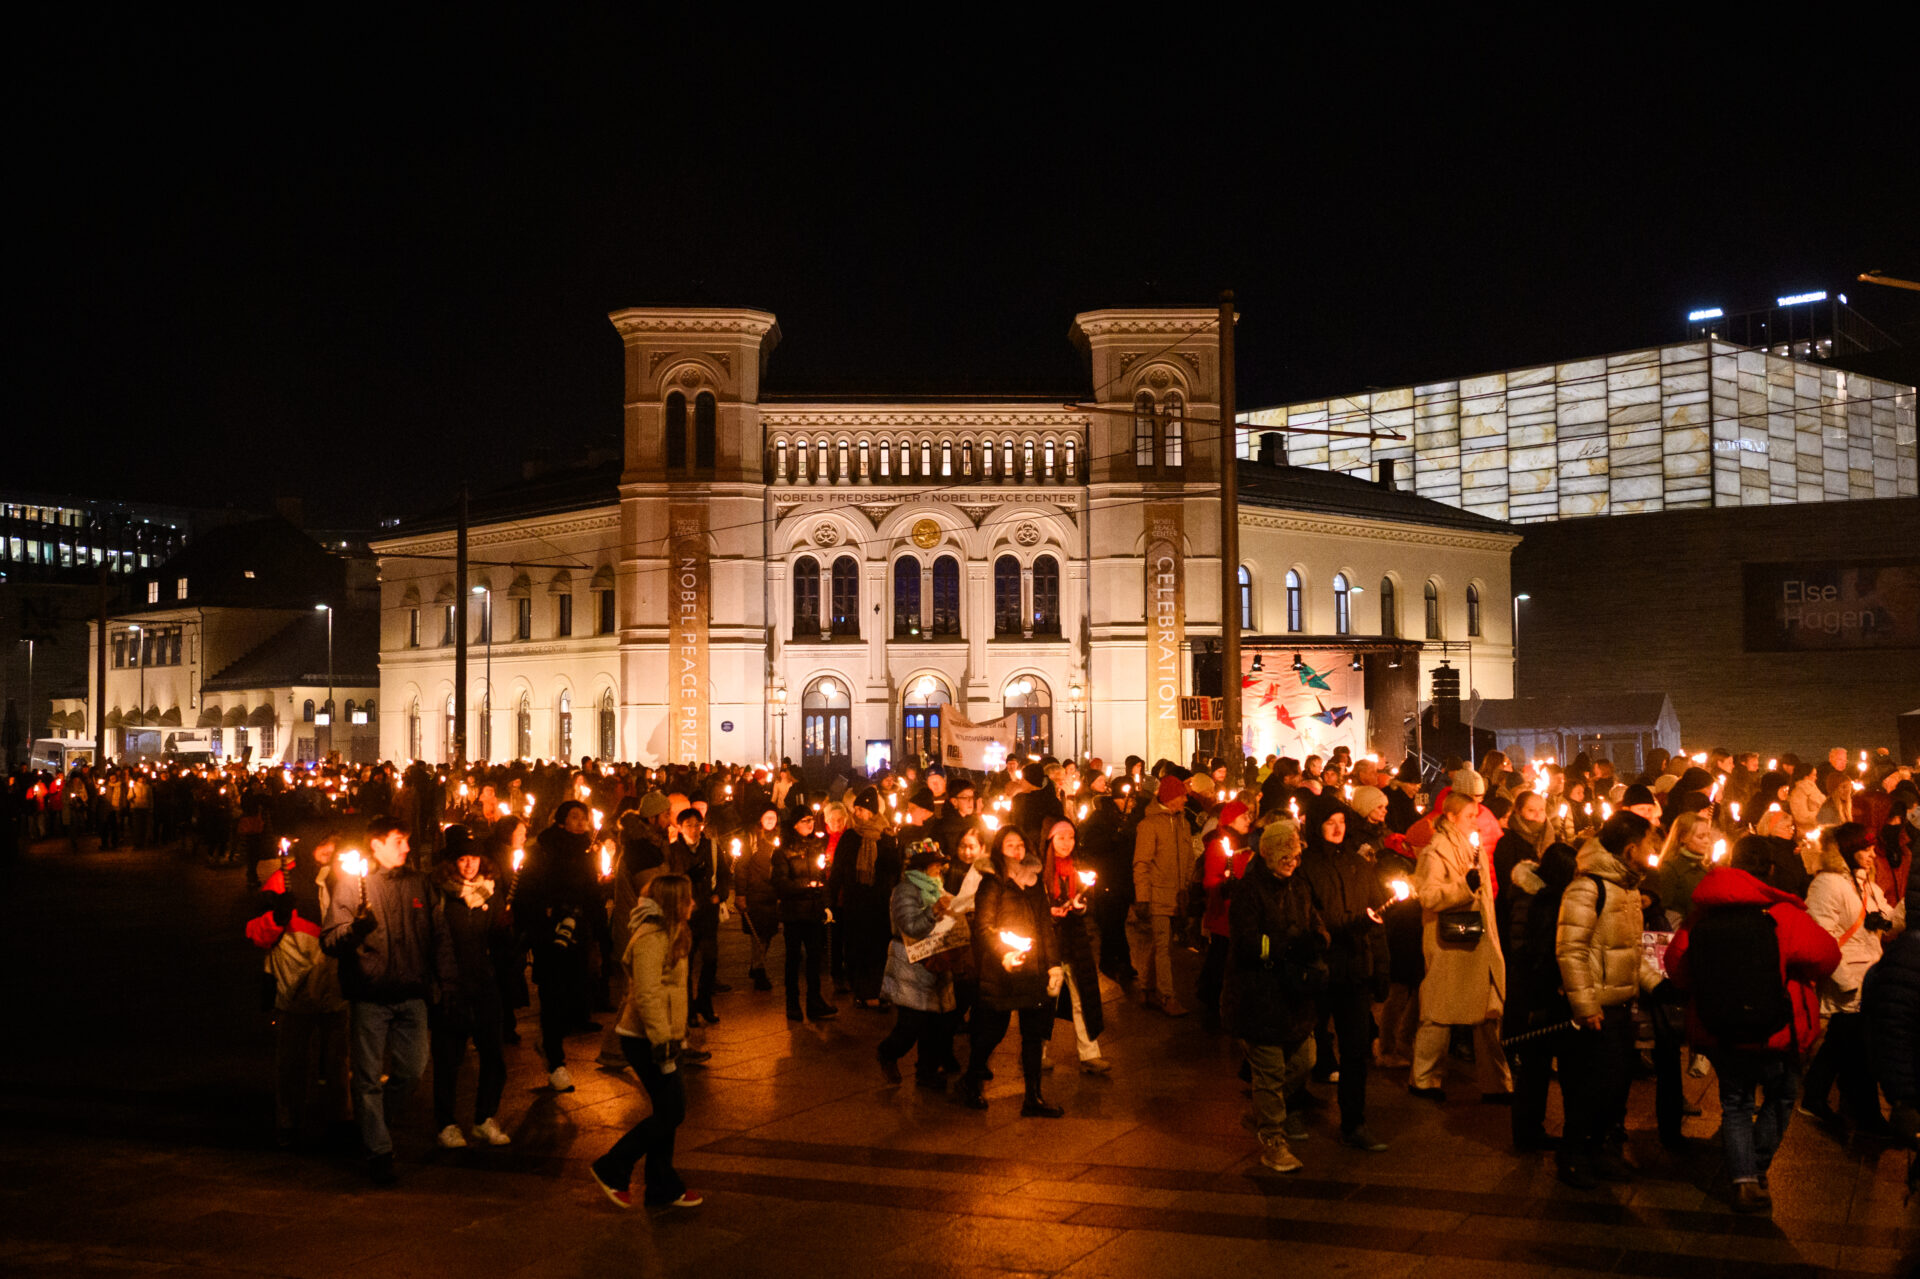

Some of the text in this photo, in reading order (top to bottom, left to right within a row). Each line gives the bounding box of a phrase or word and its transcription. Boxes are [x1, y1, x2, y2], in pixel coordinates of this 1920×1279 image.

[773, 493, 1076, 503] NOBELS FREDSSENTER NOBEL PEACE CENTER
[1783, 580, 1838, 603] Else
[1784, 606, 1875, 634] Hagen
[1156, 556, 1176, 720] CELEBRATION
[680, 558, 697, 762] NOBEL PEACE PRIZE
[1181, 697, 1202, 721] nei
